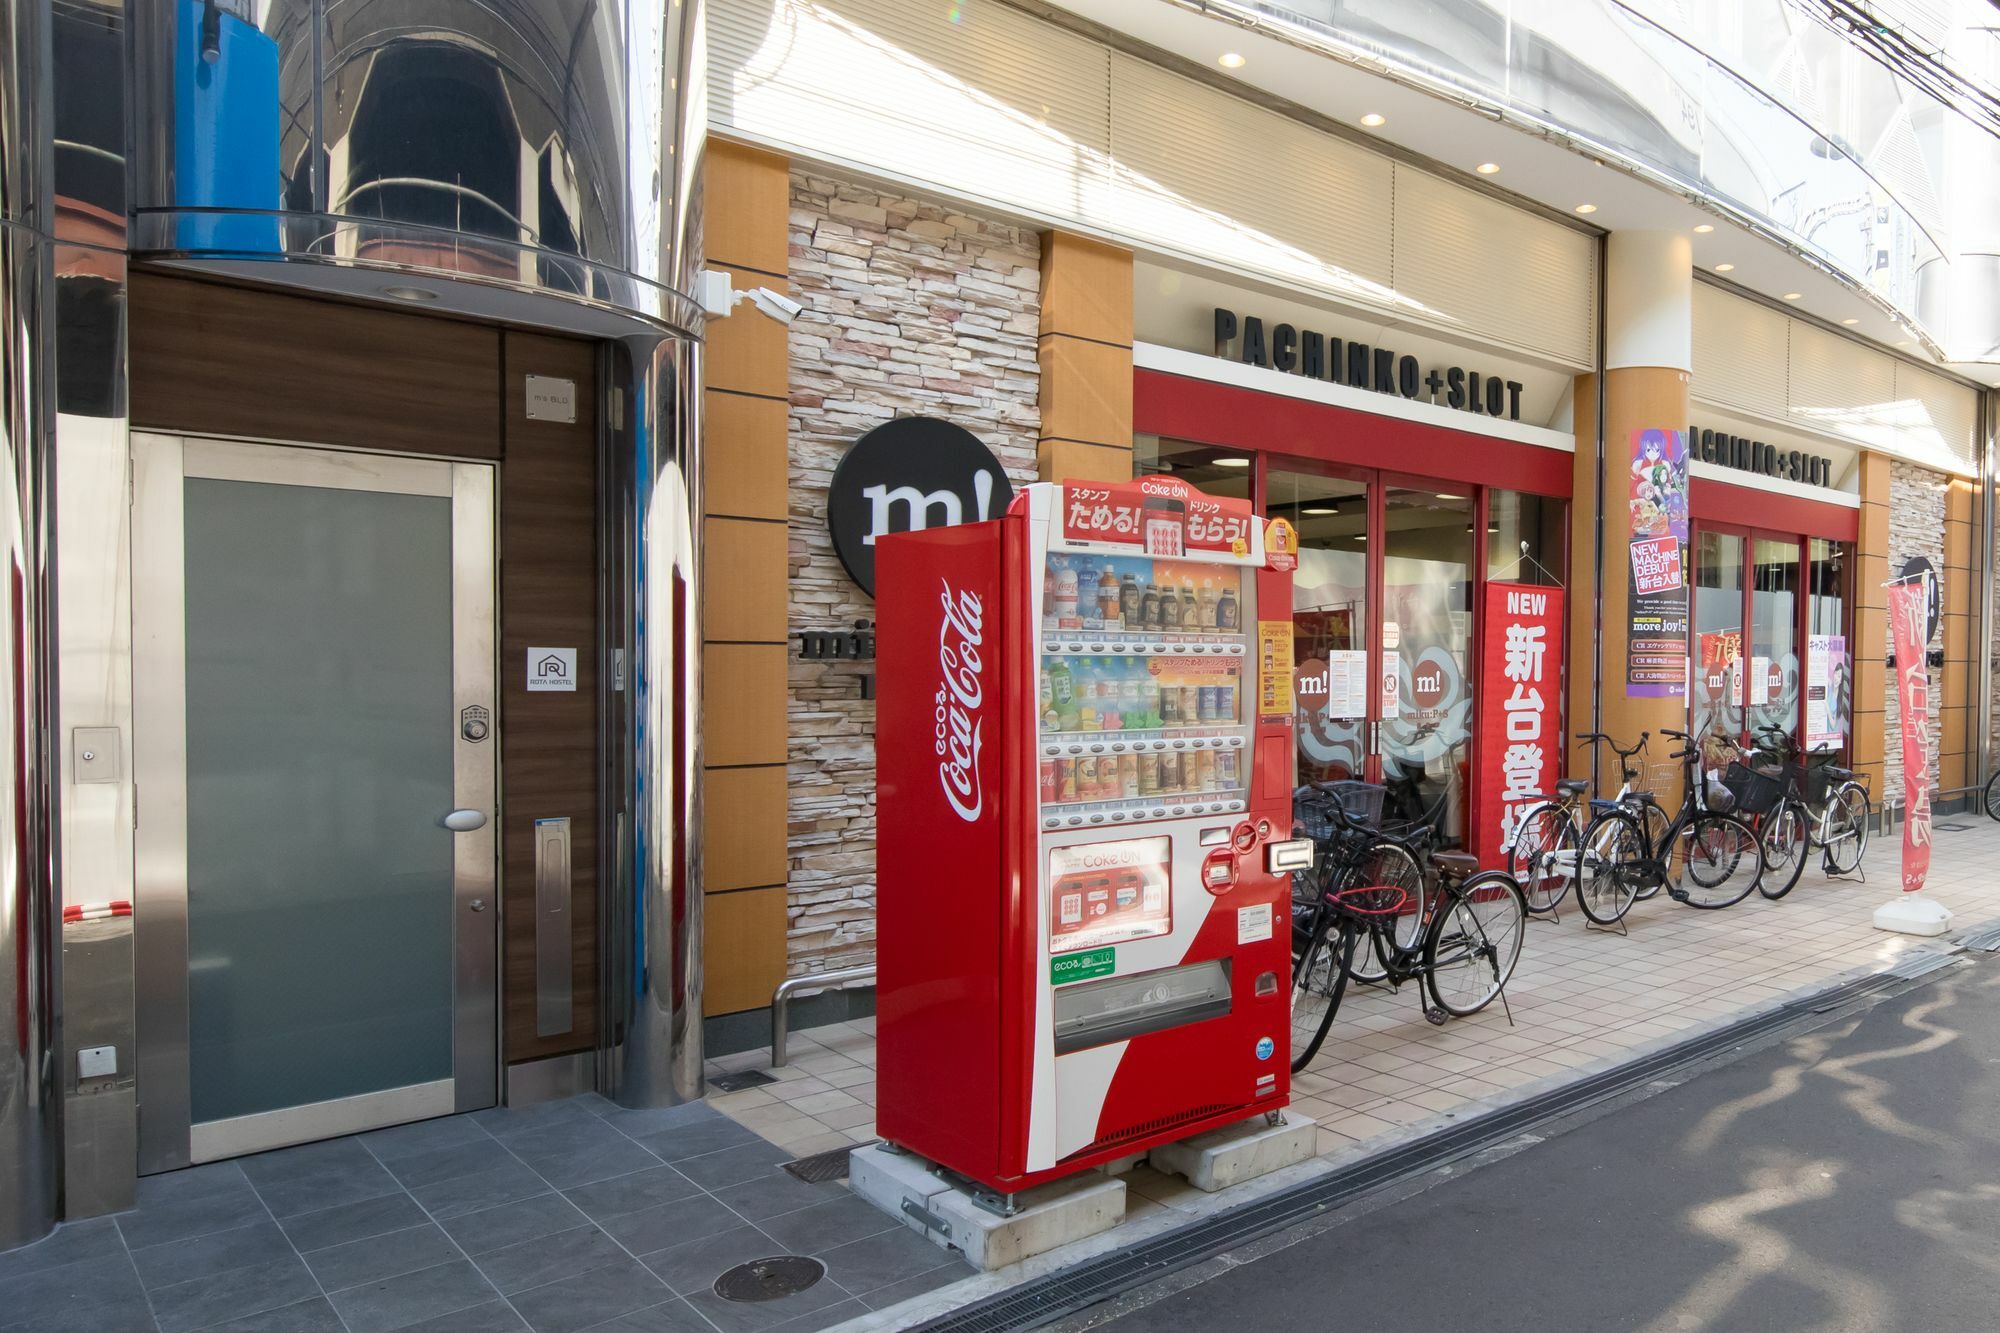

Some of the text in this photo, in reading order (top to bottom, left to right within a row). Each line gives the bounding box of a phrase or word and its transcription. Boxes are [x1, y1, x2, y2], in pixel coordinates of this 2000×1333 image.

[1214, 307, 1523, 421] PACHINKO+SLOT
[1689, 425, 1832, 488] ACHINKO+SLOT
[1071, 487, 1110, 501] スタンプ
[1141, 482, 1189, 498] Coke ON
[863, 469, 993, 546] m!
[1190, 501, 1220, 514] ドリンク
[1068, 501, 1142, 535] ためる!
[1187, 514, 1249, 543] もらう!
[1632, 542, 1659, 557] NEW
[1634, 550, 1679, 567] MACHINE
[1636, 562, 1670, 577] DEBUT
[1639, 571, 1680, 590] 新台入替
[1507, 591, 1546, 616] NEW
[1633, 619, 1681, 632] more joy!
[1300, 670, 1328, 694] m!
[1416, 670, 1441, 693] m!
[1708, 671, 1724, 687] m!
[1768, 671, 1782, 687] m!
[940, 577, 983, 822] Coca-Cola
[1083, 855, 1119, 868] Coke
